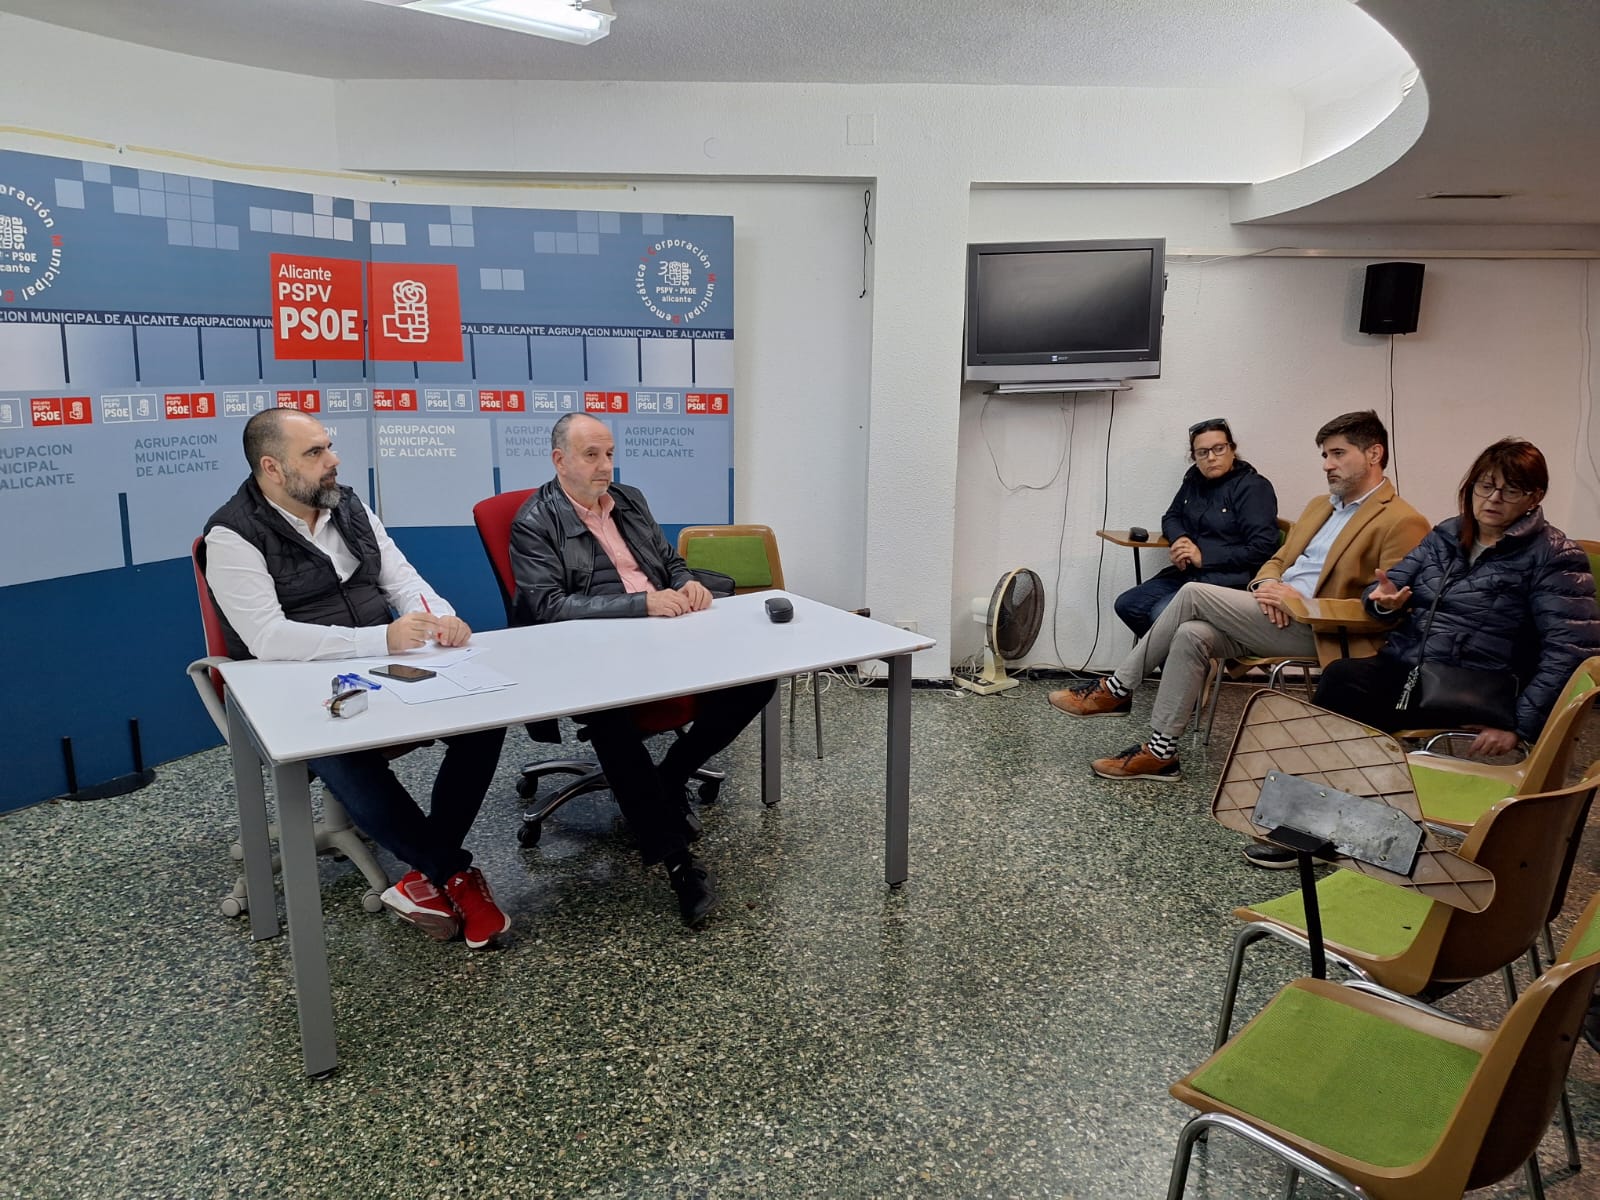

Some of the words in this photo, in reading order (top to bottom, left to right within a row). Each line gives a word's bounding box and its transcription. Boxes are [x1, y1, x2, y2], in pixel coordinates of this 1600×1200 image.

[12, 251, 38, 262] PSOE
[21, 234, 65, 301] Municipal
[278, 263, 333, 282] Alicante
[278, 281, 333, 303] PSPV
[656, 286, 673, 294] PSPV
[680, 287, 697, 295] PSOE
[662, 295, 692, 303] alicante
[31, 312, 102, 325] MUNICIPAL
[104, 314, 120, 325] DE
[123, 315, 180, 326] ALICANTE
[182, 316, 250, 328] AGRUPACION
[279, 306, 360, 342] PSOE
[481, 326, 495, 334] DE
[497, 325, 546, 335] ALICANTE
[548, 326, 610, 337] AGRUPACION
[612, 328, 664, 338] MUNICIPAL
[666, 329, 679, 338] DE
[681, 330, 727, 339] ALICANTE
[226, 403, 247, 412] PSOE
[278, 401, 298, 409] PSOE
[329, 399, 347, 408] PSOE
[427, 399, 448, 408] PSOE
[480, 400, 501, 408] PSOE
[586, 401, 606, 409] PSOE
[638, 402, 657, 410] PSOE
[687, 402, 705, 410] PSOE
[104, 408, 129, 418] PSOE
[166, 405, 190, 415] PSOE
[33, 411, 61, 421] PSOE
[378, 424, 456, 435] AGRUPACION
[624, 426, 695, 436] AGRUPACION
[134, 433, 218, 450] AGRUPACION
[379, 436, 444, 446] MUNICIPAL
[624, 437, 683, 447] MUNICIPAL
[135, 448, 206, 463] MUNICIPAL
[380, 448, 399, 457] DE
[400, 448, 457, 457] ALICANTE
[505, 448, 523, 457] DE
[523, 448, 551, 457] ALIC
[624, 448, 639, 458] DE
[640, 448, 695, 458] ALICANTE
[136, 466, 153, 478] DE
[157, 460, 220, 476] ALICANTE
[0, 473, 76, 490] ALICANTE
